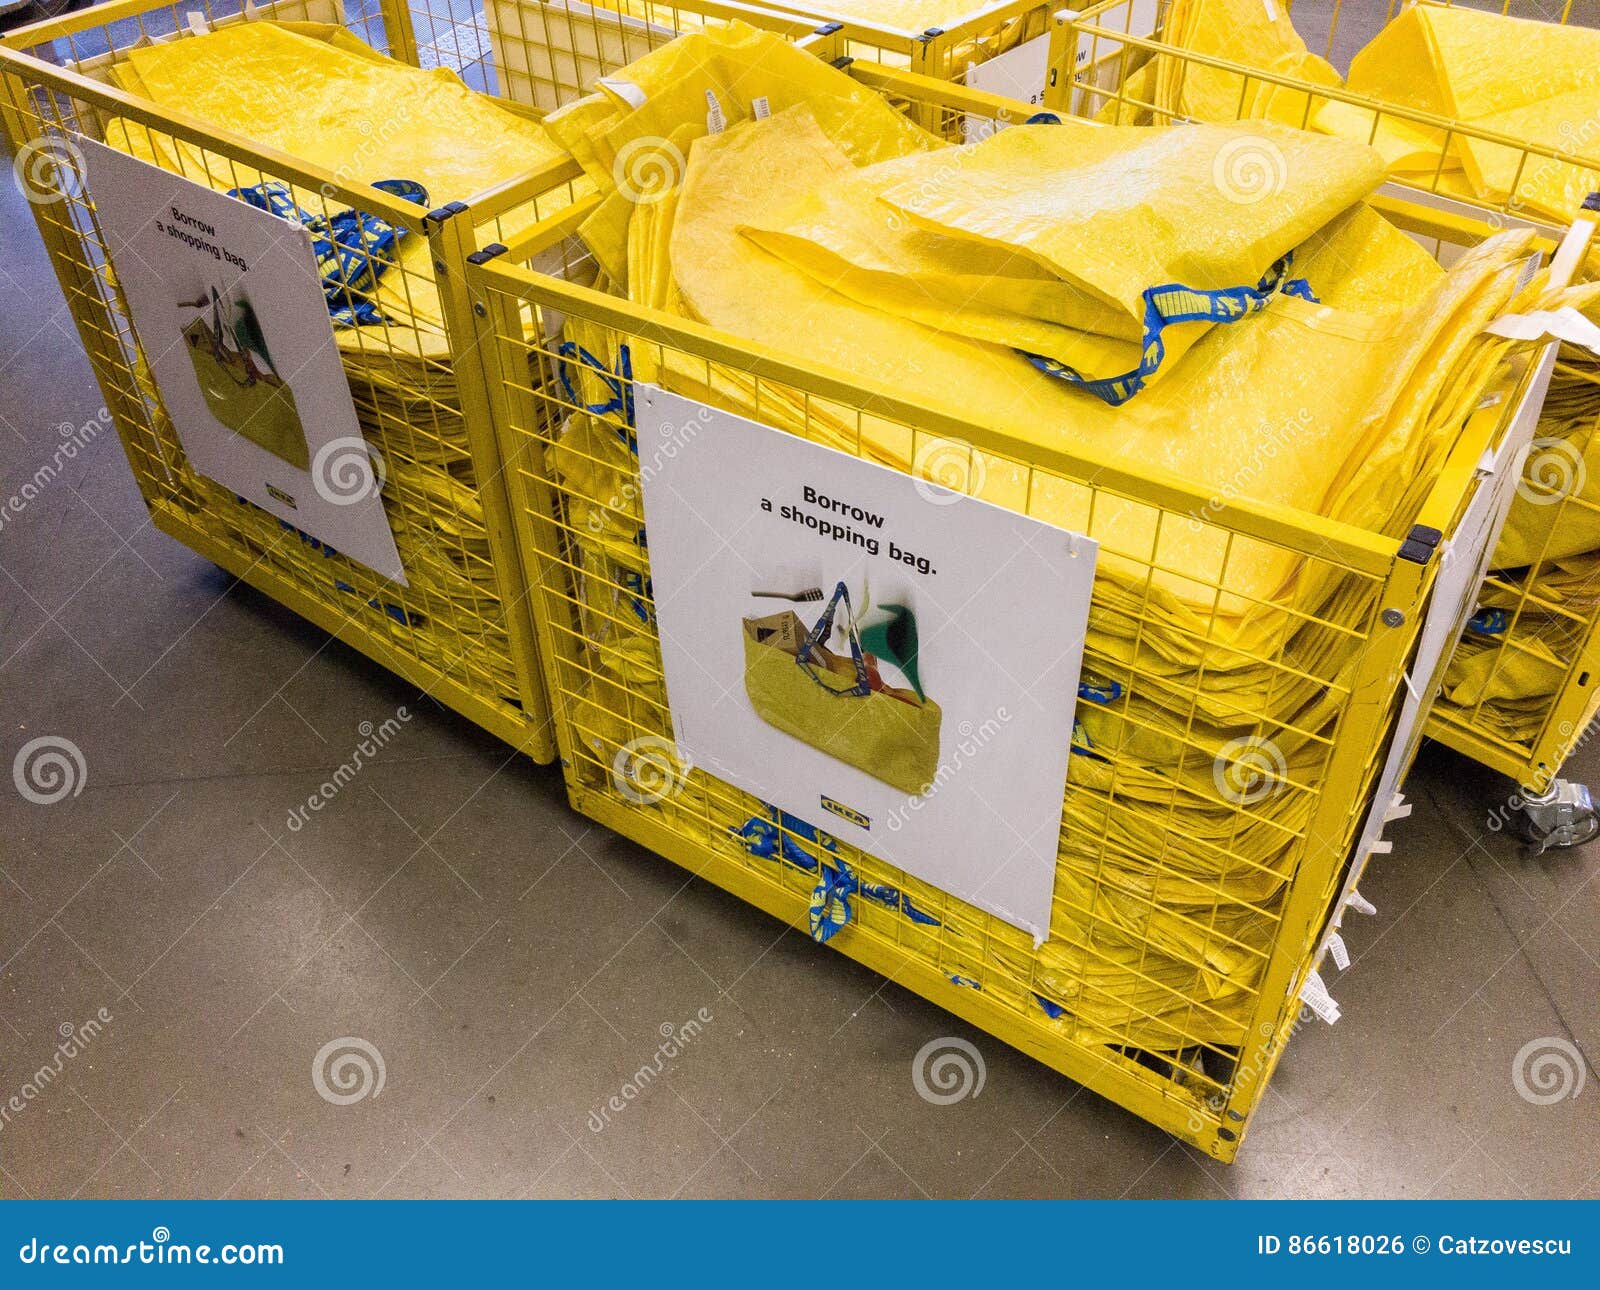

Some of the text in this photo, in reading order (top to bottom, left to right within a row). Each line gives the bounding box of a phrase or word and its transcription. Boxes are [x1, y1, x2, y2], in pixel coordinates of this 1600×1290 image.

[171, 206, 215, 236] Borrow
[156, 220, 250, 272] a shopping bag.
[803, 485, 885, 529] Borrow
[760, 498, 937, 575] a shopping bag.
[824, 797, 867, 827] IKEA
